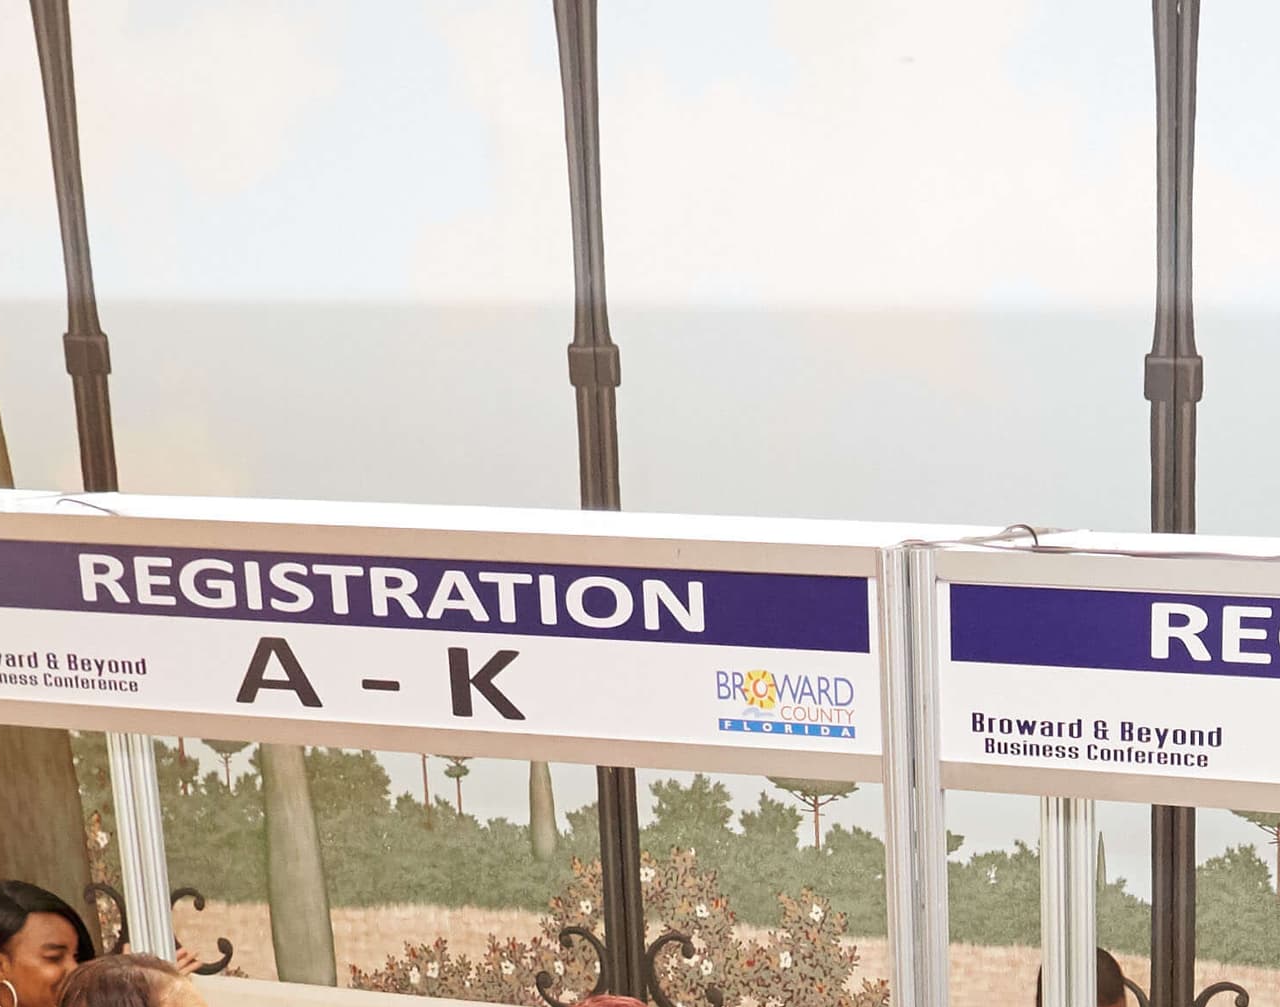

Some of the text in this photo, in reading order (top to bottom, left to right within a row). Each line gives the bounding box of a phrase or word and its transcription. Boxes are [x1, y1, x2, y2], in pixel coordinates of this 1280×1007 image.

[78, 553, 706, 632] REGISTRATION
[46, 652, 60, 670] &
[67, 653, 148, 678] Beyond
[236, 636, 323, 708] A
[447, 647, 526, 721] K
[43, 671, 139, 692] Conference
[716, 670, 854, 707] BROWARD
[724, 720, 851, 737] FLORIDA
[781, 705, 855, 724] COUNTY
[971, 711, 1223, 749] Broward & Beyond
[984, 737, 1209, 768] Business Conference
